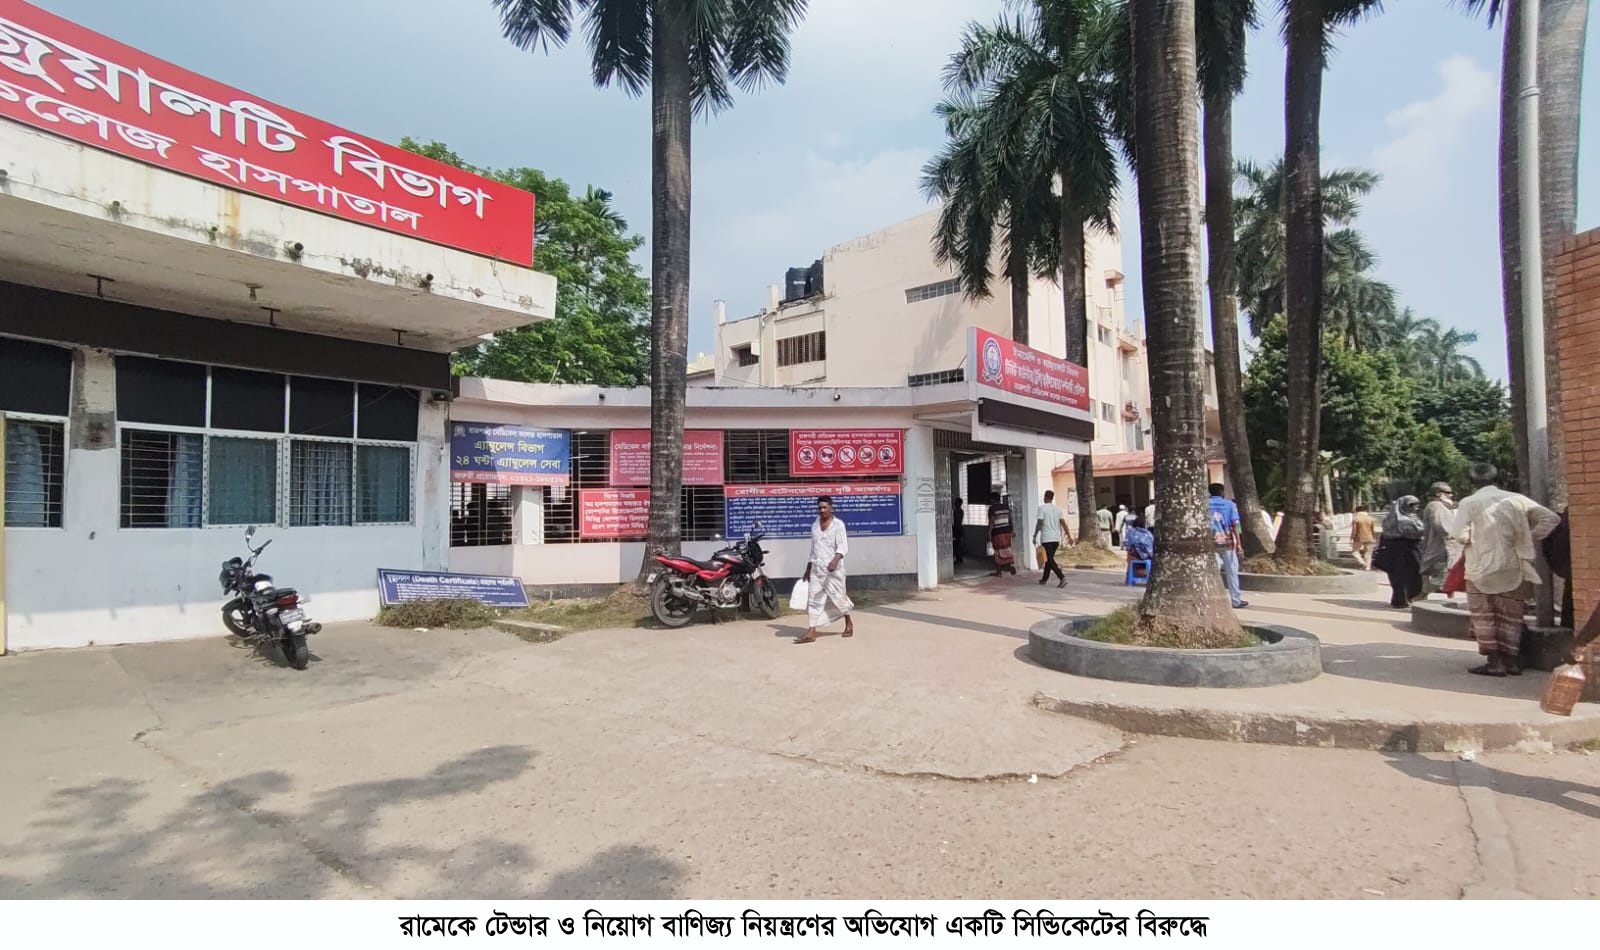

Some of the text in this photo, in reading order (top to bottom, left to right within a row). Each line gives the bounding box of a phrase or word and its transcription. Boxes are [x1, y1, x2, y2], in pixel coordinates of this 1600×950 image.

[192, 144, 424, 231] হাসপাতাল
[321, 136, 493, 219] বিভাগ
[455, 455, 470, 467] ২৪
[540, 459, 562, 470] সেবা
[517, 440, 545, 455] বিভাগ
